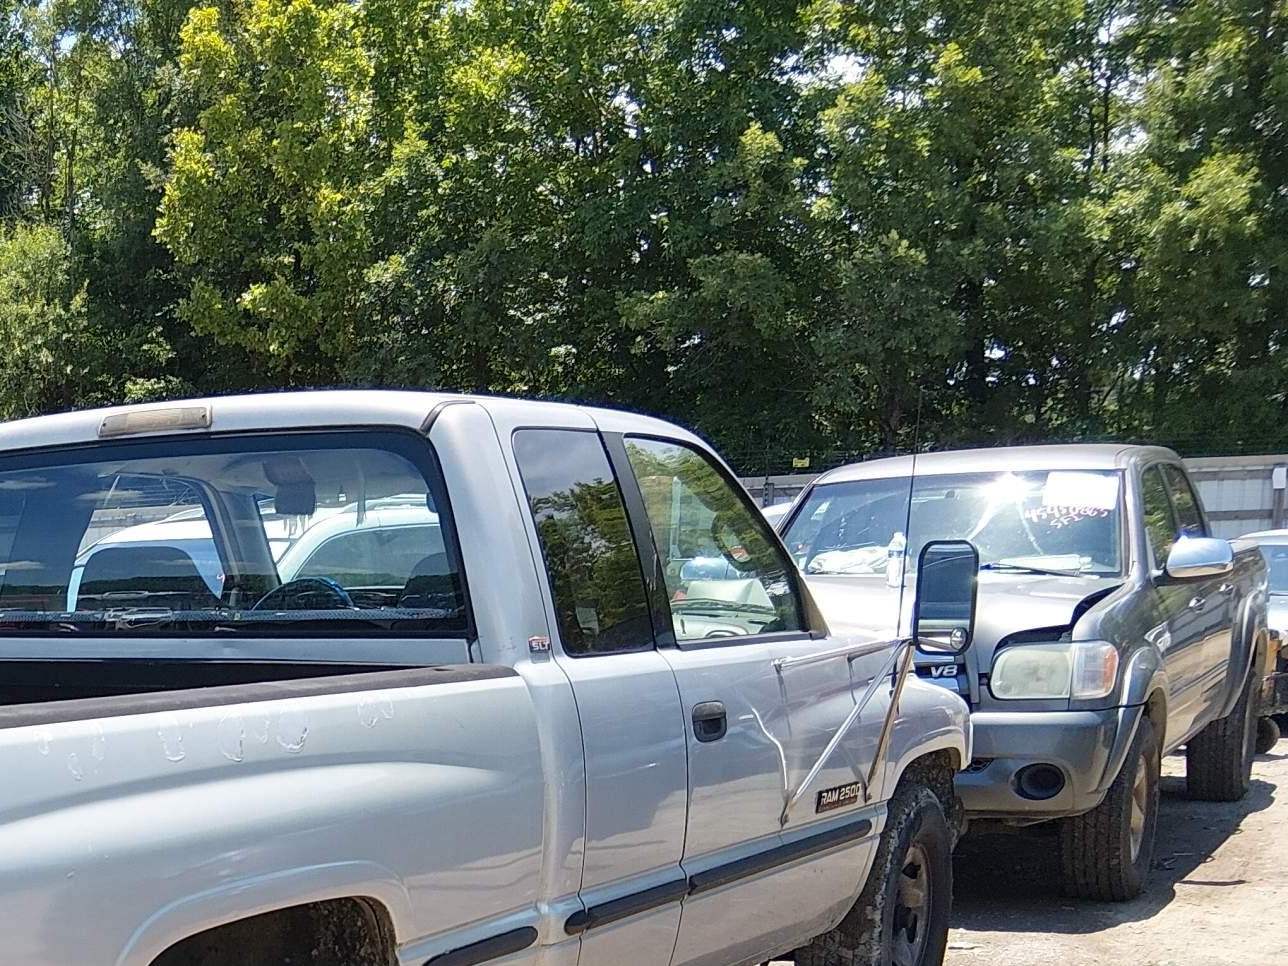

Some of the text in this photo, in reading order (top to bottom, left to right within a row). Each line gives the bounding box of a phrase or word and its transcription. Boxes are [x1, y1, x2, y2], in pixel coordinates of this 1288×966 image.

[532, 641, 550, 650] SLT
[930, 664, 958, 678] V8
[821, 789, 839, 805] RAM
[839, 783, 861, 800] 2500
